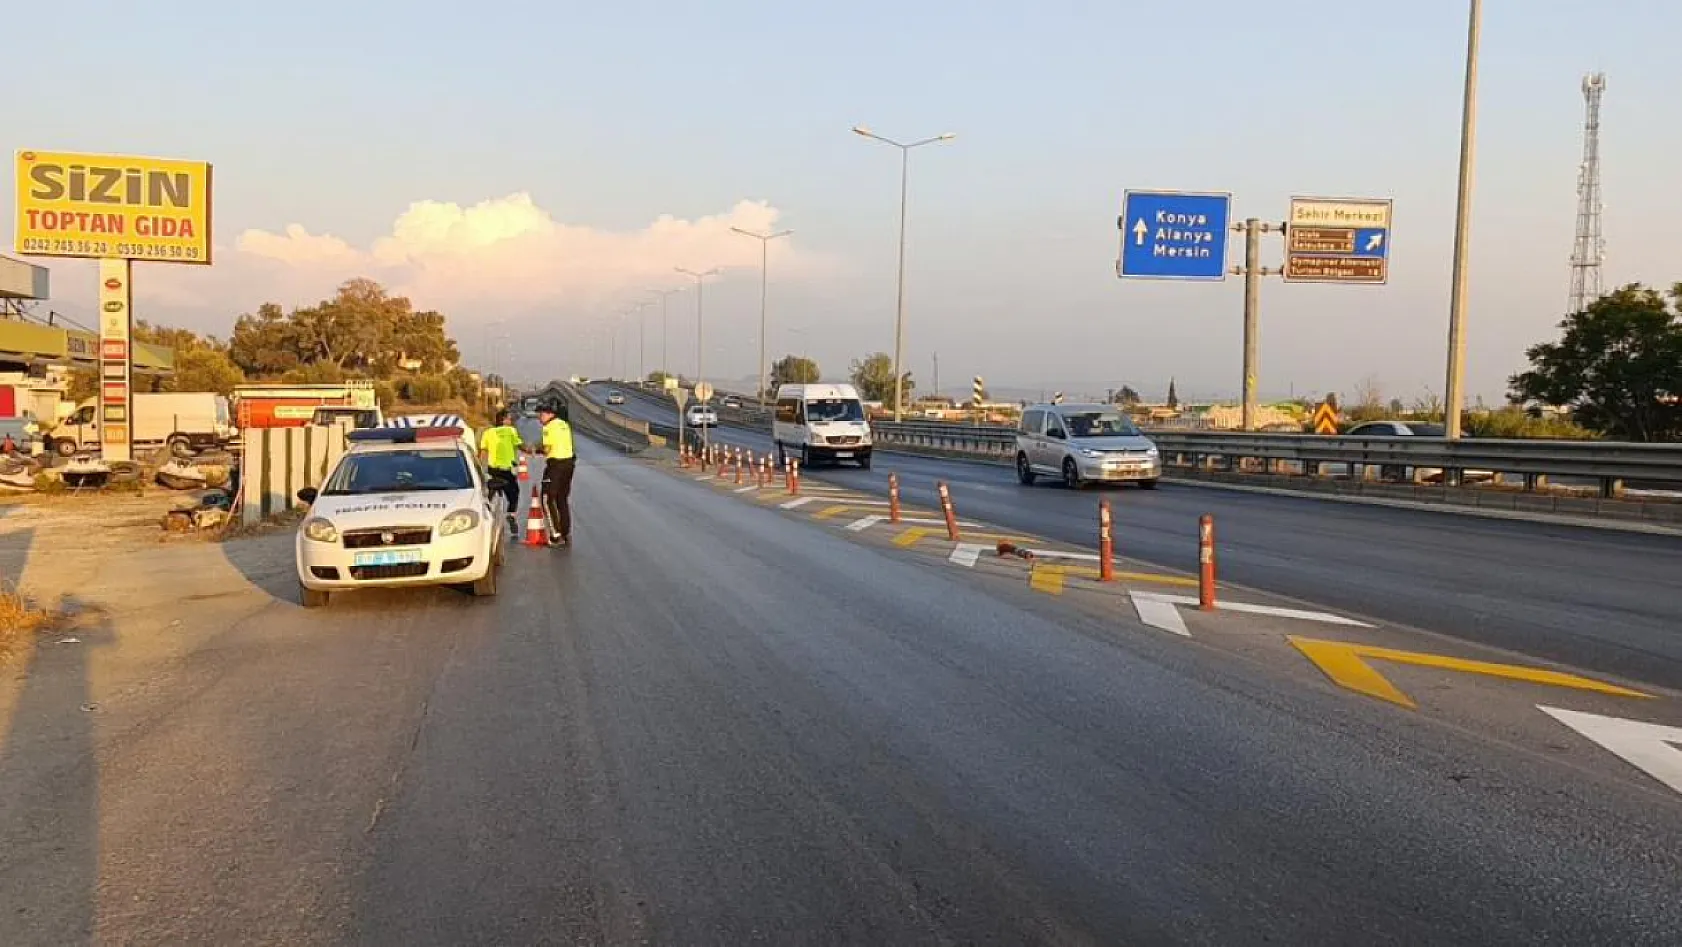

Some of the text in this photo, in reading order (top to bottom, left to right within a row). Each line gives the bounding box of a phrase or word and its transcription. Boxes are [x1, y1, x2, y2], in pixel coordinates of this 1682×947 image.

[26, 209, 195, 238] TOPTAN GIDA
[1155, 210, 1207, 227] Konya
[1155, 228, 1212, 243] Alanya
[23, 238, 50, 250] 0242
[1154, 244, 1209, 257] Mersin
